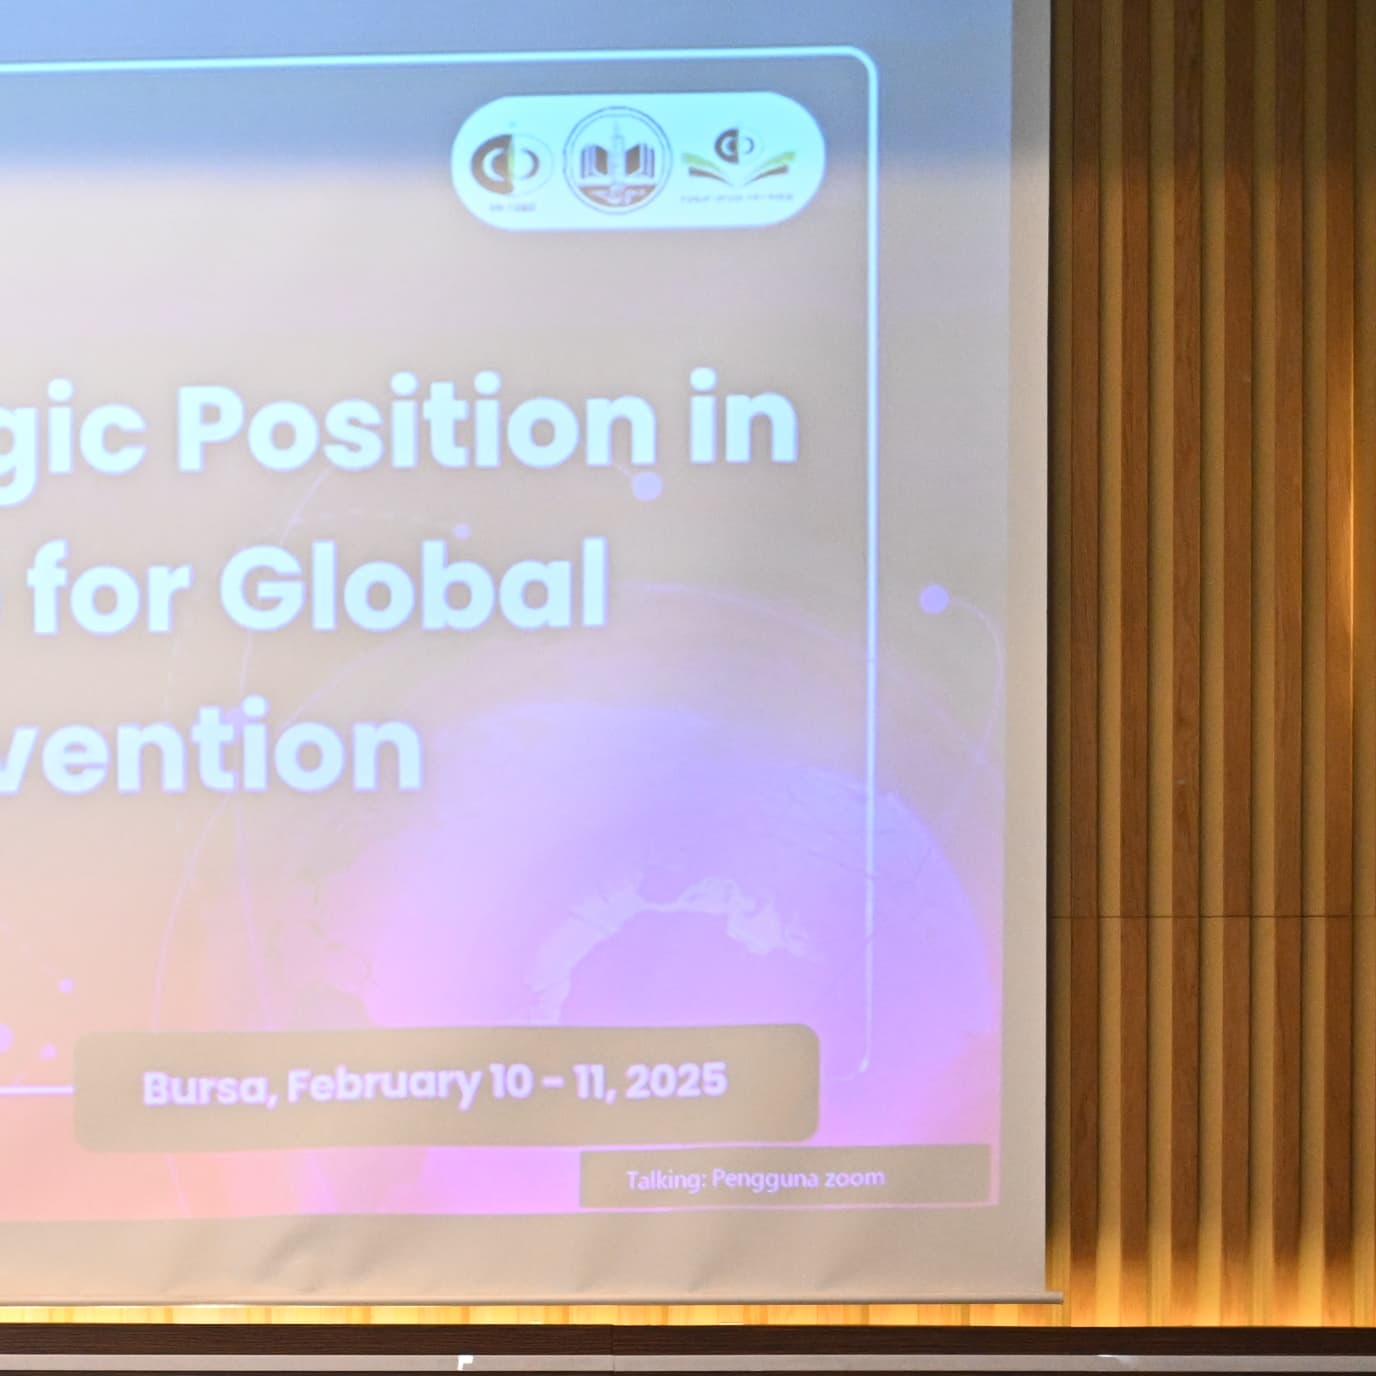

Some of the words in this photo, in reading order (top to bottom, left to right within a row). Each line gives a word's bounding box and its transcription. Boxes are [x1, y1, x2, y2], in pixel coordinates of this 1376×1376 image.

[179, 371, 656, 474] Position
[691, 368, 796, 462] in
[27, 540, 191, 634] for
[221, 536, 606, 632] Global
[144, 1072, 277, 1108] Bursa,
[288, 1067, 482, 1110] February
[490, 1064, 532, 1098] 10
[574, 1065, 616, 1103] 11,
[626, 1062, 727, 1098] 2025
[627, 1170, 706, 1194] Talking:
[713, 1168, 819, 1193] Pengguna
[825, 1172, 885, 1187] zoom
